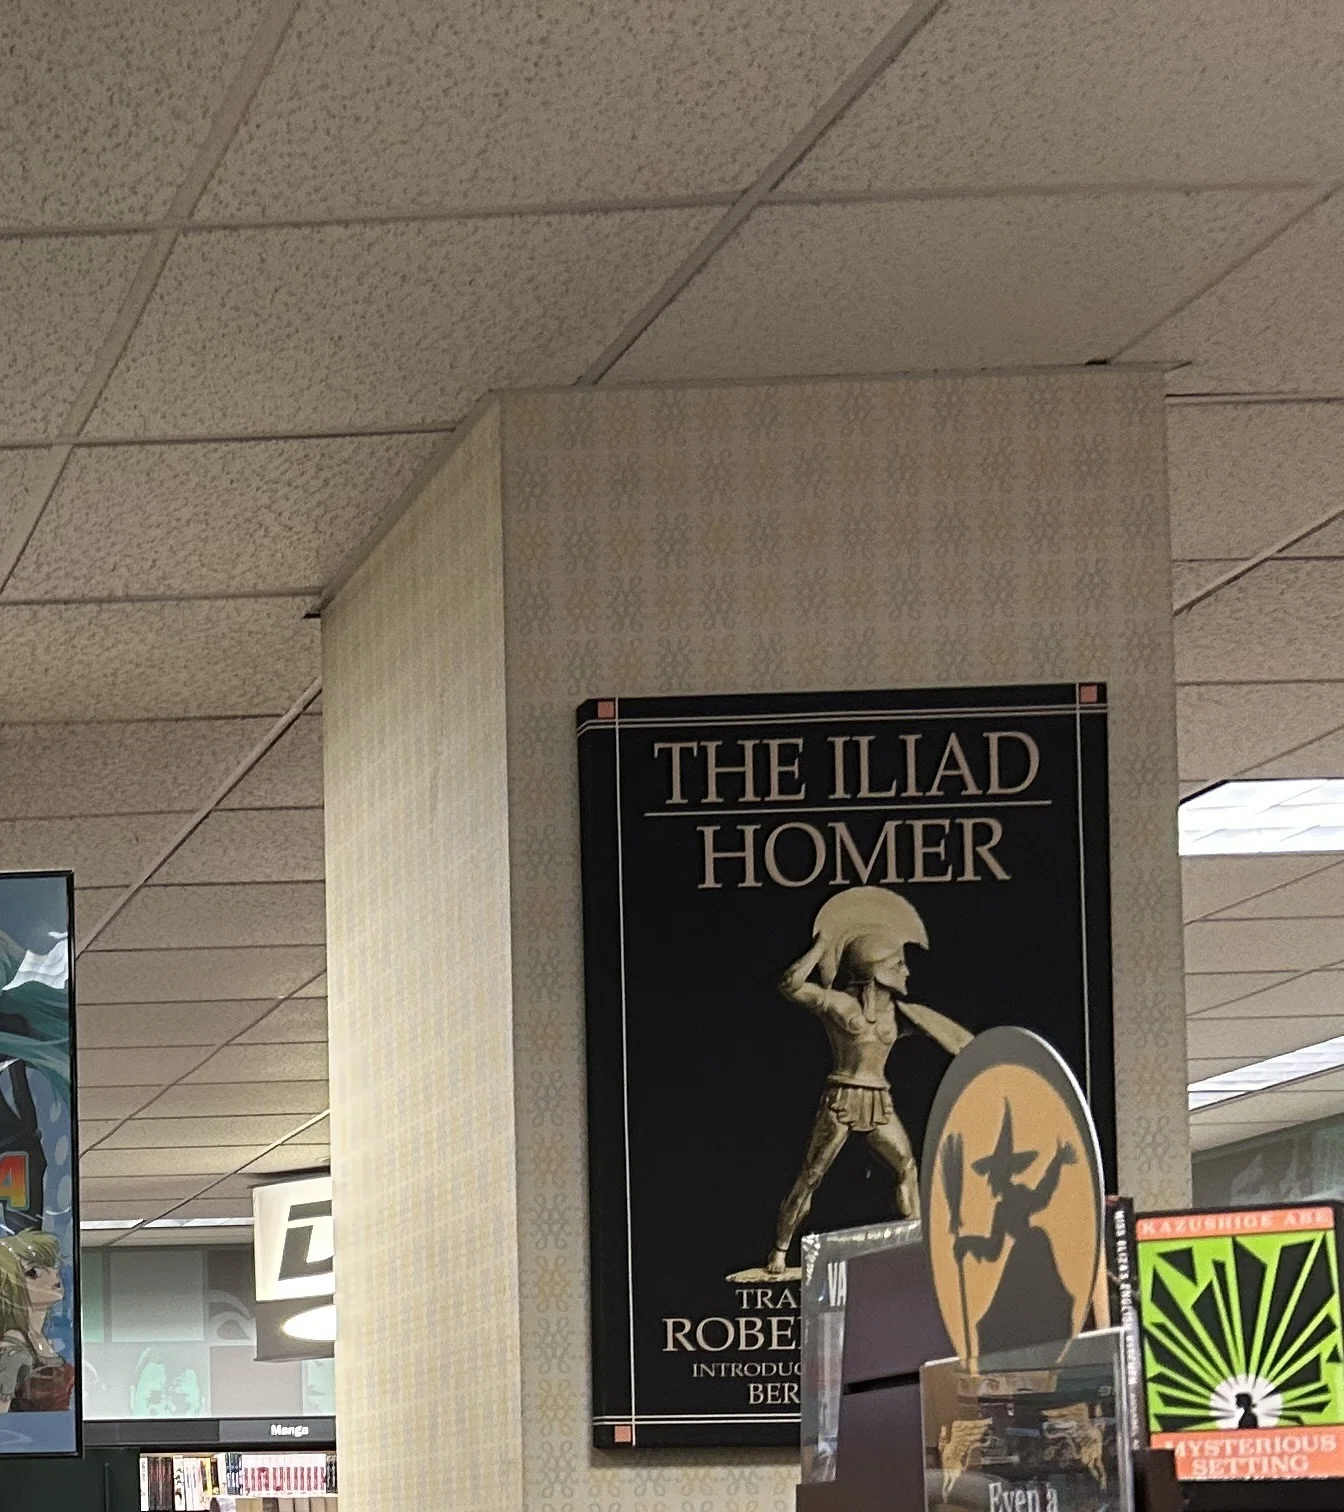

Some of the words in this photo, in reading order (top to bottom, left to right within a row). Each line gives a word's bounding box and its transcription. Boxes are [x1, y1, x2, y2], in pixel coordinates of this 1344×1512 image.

[654, 736, 807, 804] THE
[826, 731, 1041, 799] ILIAD
[696, 817, 1012, 889] HOMER
[1142, 1211, 1273, 1235] KAZUSHIGE
[1283, 1207, 1327, 1226] ABE
[735, 1287, 801, 1309] TRA
[662, 1316, 801, 1352] ROBE
[270, 1424, 309, 1438] Manga
[1167, 1434, 1337, 1458] MYSTERIOUS
[1191, 1454, 1309, 1476] SETTING
